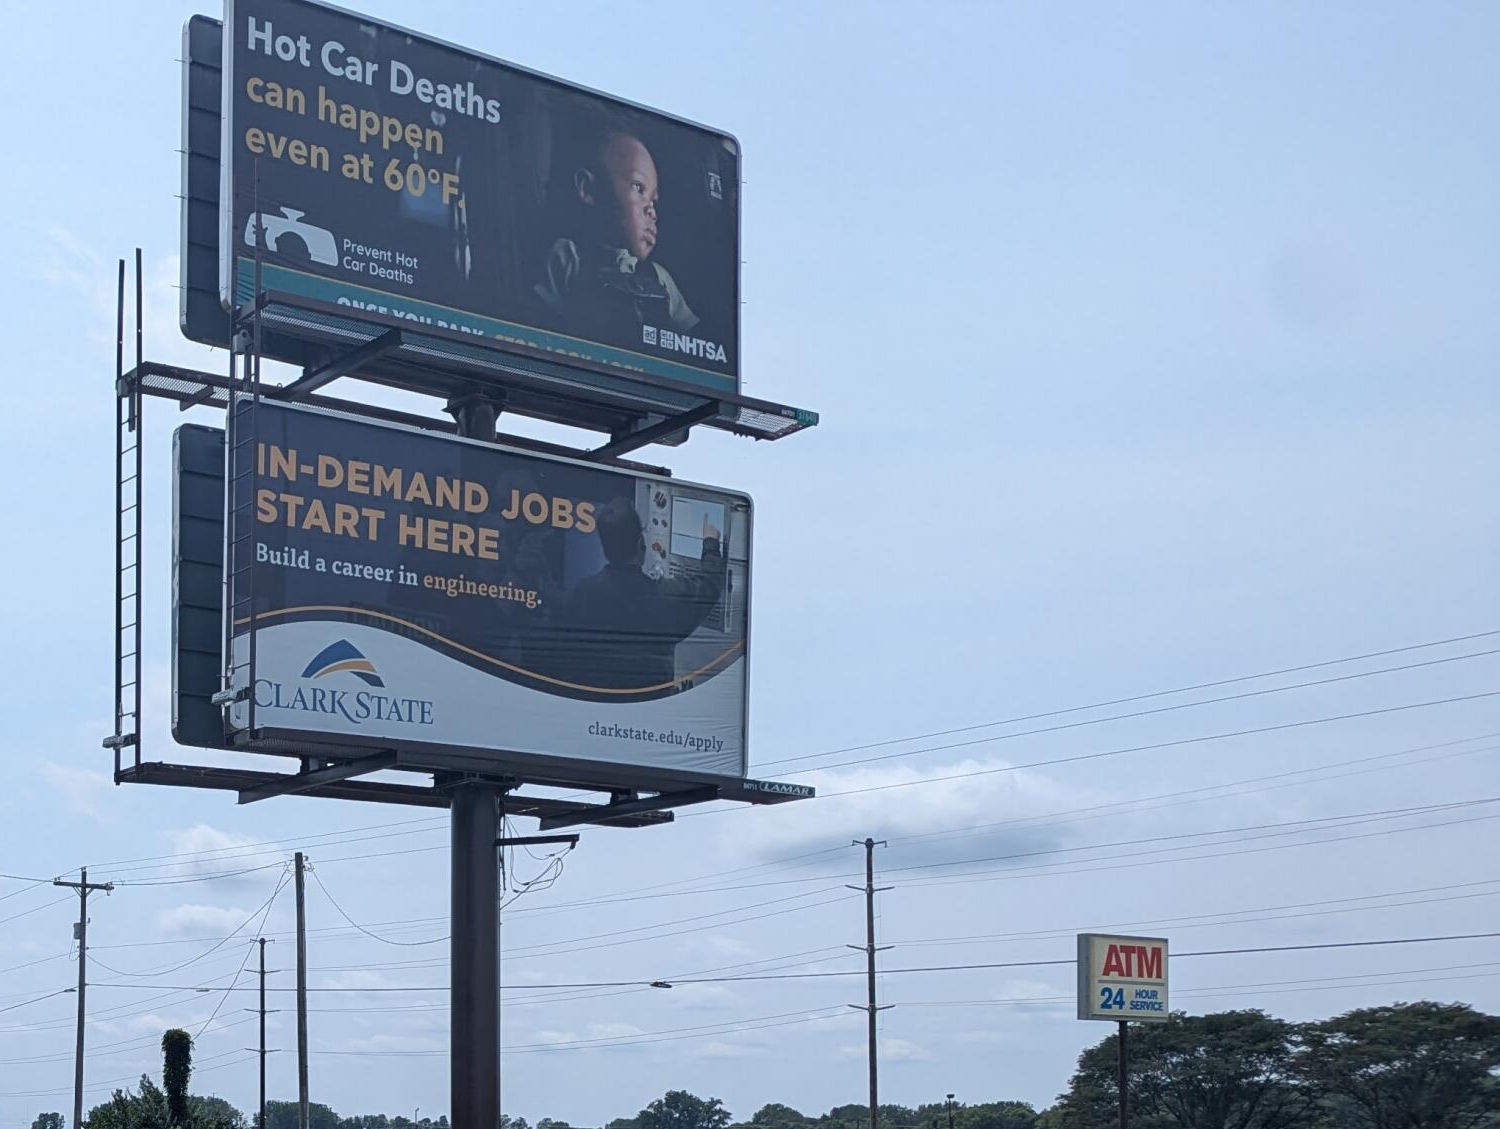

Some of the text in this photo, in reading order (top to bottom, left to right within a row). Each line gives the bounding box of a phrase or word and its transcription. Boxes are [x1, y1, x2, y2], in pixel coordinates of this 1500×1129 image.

[247, 15, 501, 124] Hot Car Deaths
[246, 77, 444, 154] can happen
[245, 126, 329, 171] even
[341, 153, 374, 184] at
[343, 238, 419, 269] Prevent Hot
[342, 256, 414, 285] Car Deaths
[674, 332, 728, 363] NHTSA
[257, 443, 596, 533] IN-DEMAND JOBS
[256, 489, 500, 561] START HERE
[256, 542, 542, 609] Build a career in engineering.
[254, 679, 434, 725] CLARK STATE
[588, 721, 724, 753] clarkstate.edu/apply
[764, 783, 810, 795] LAMAR
[1102, 944, 1162, 979] ATM
[1100, 987, 1126, 1010] 24
[1130, 1000, 1164, 1011] SERVICE
[1135, 989, 1158, 1000] HOUR
